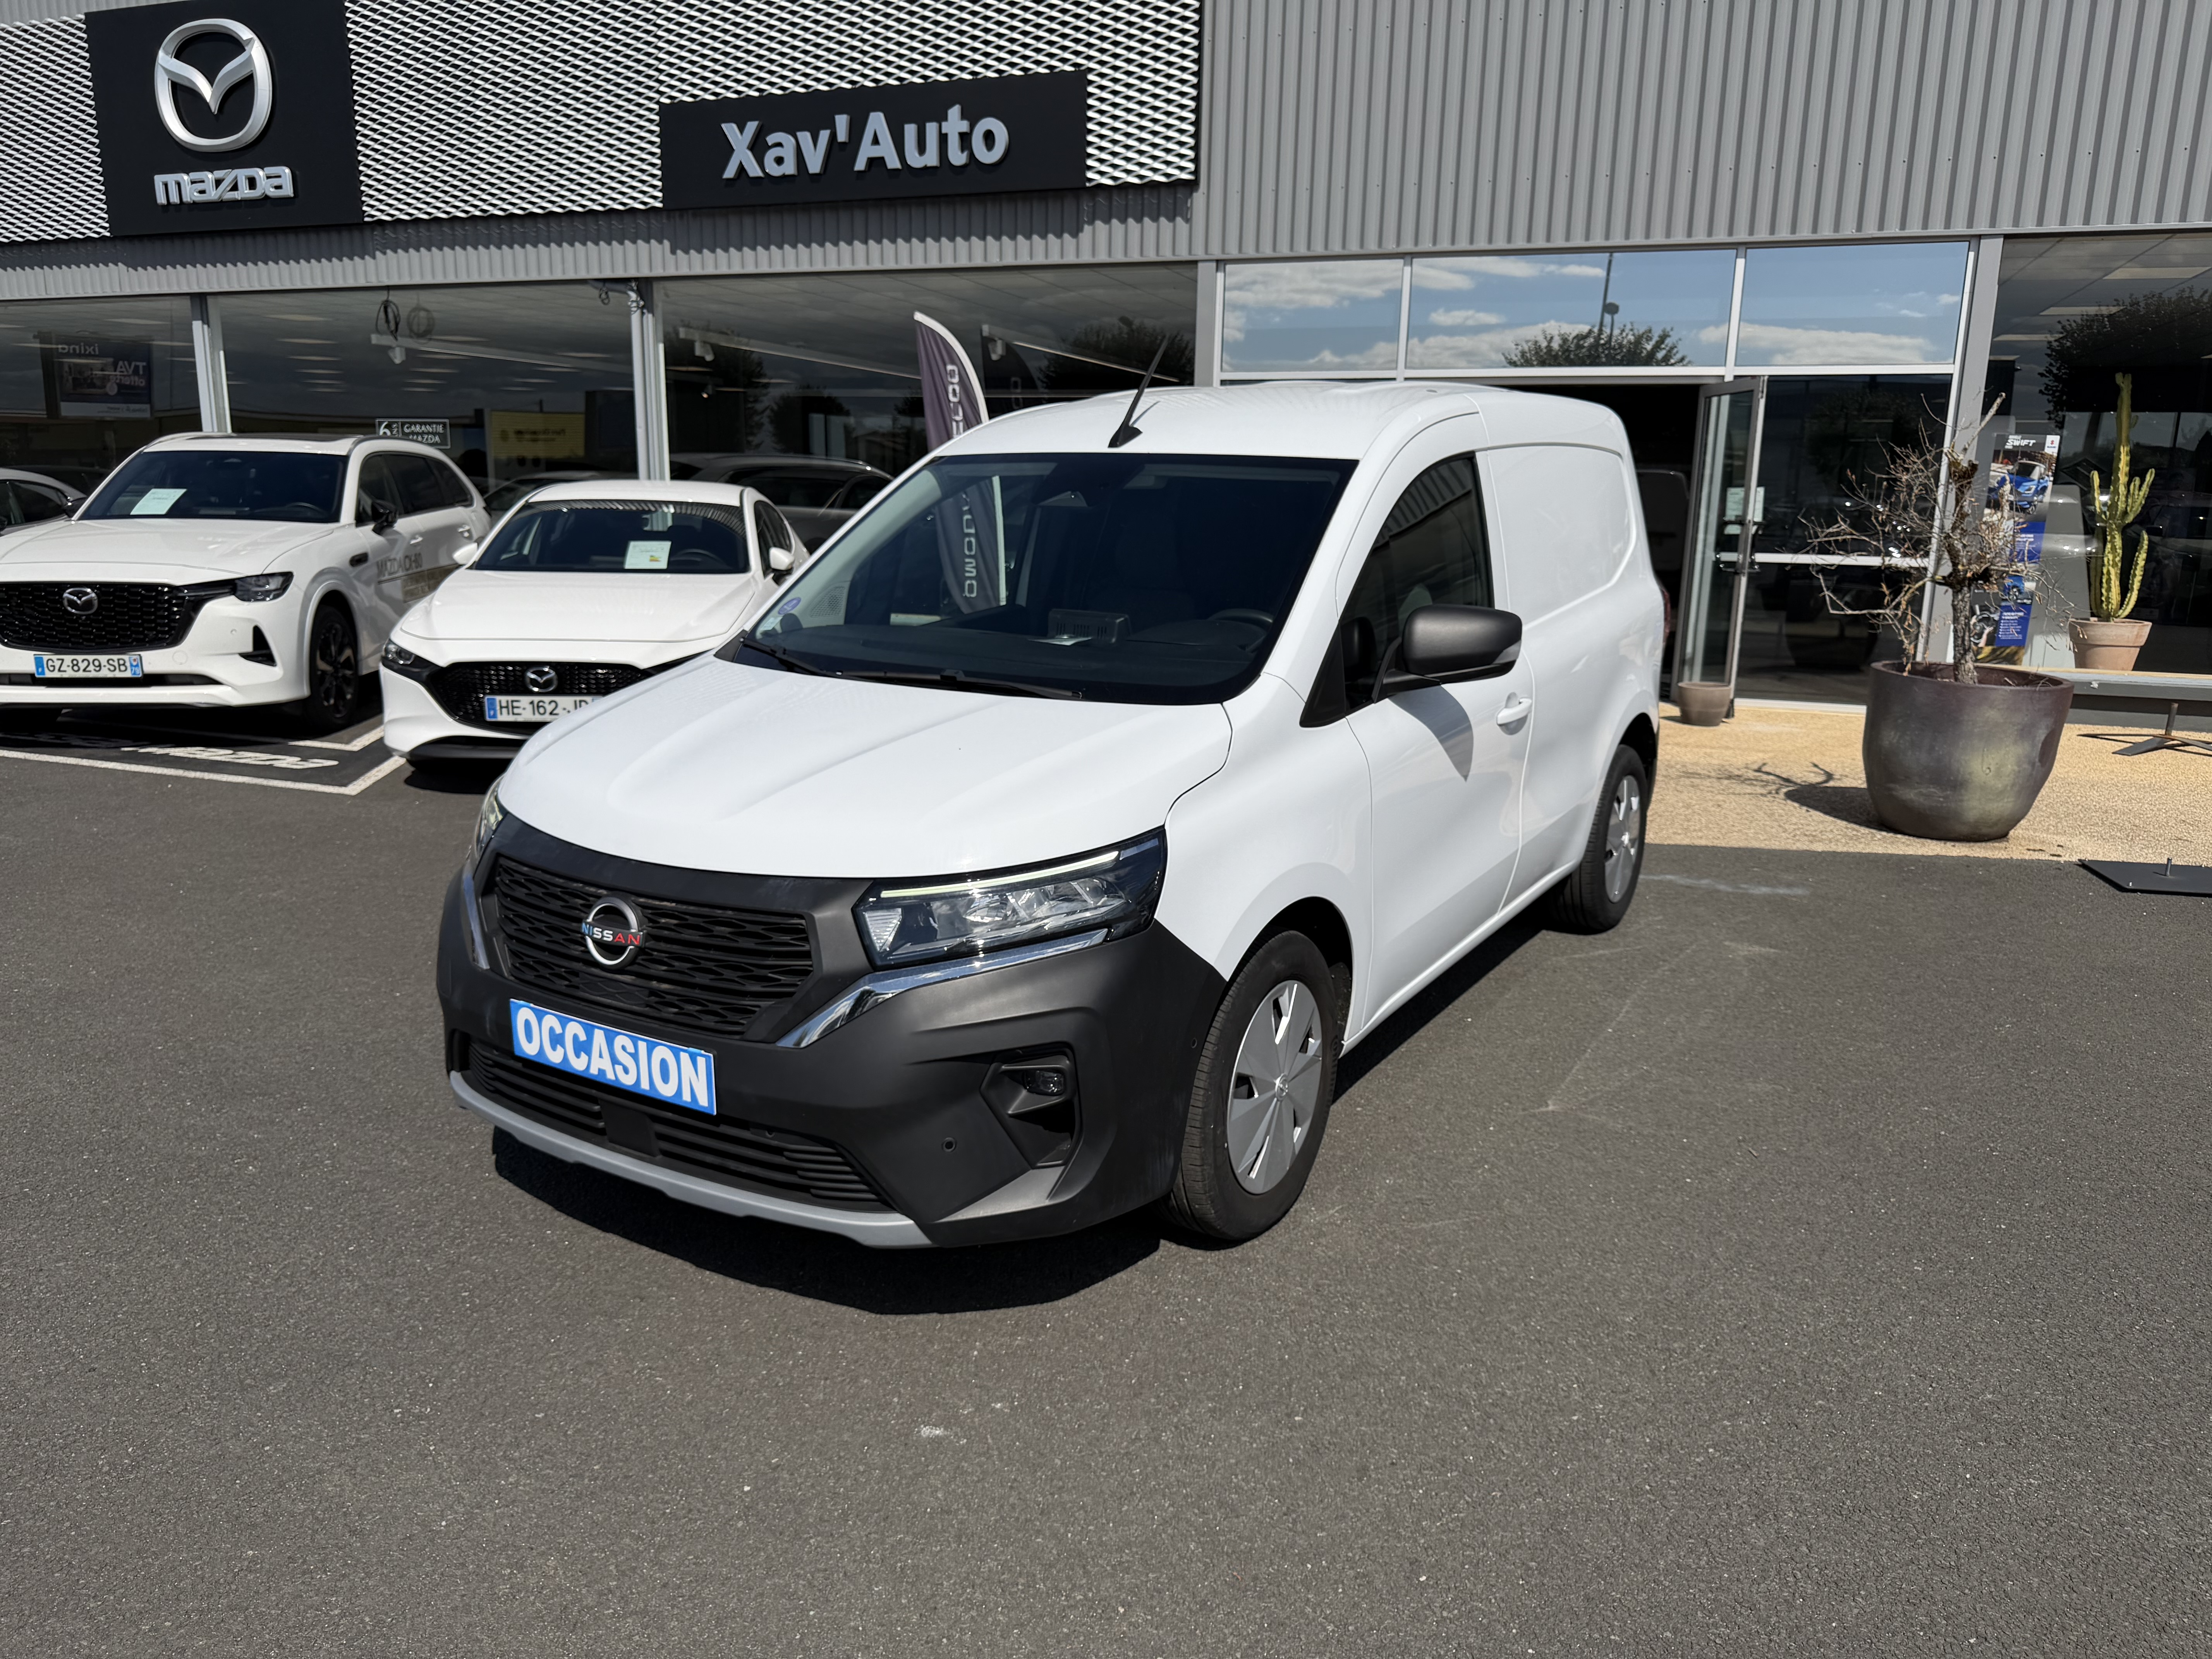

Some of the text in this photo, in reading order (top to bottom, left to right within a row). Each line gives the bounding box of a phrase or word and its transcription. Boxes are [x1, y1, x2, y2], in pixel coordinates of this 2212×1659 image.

[403, 423, 445, 433] GARANTIE
[46, 658, 128, 673] GZ-829-SB
[582, 922, 641, 945] NISSAN
[517, 1007, 709, 1107] OCCASION
